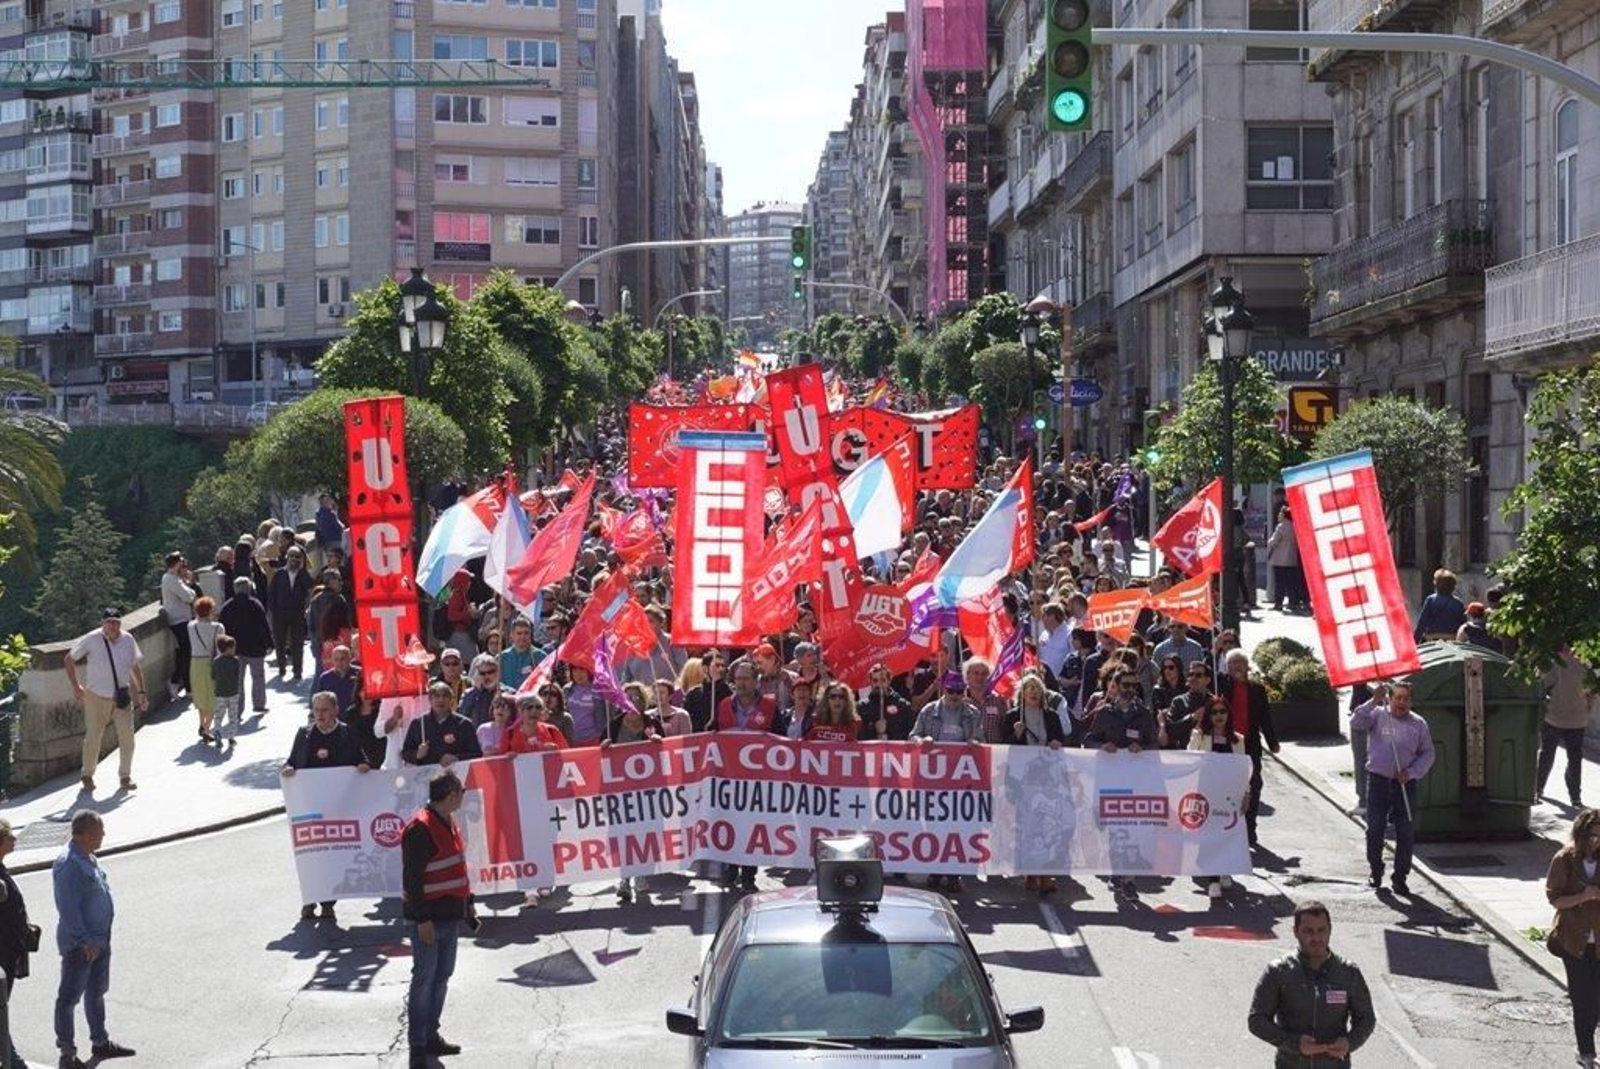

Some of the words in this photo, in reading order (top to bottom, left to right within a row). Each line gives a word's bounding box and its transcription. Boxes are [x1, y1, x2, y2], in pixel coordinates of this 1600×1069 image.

[361, 437, 407, 660] UGT
[692, 451, 746, 631] CCOO
[1304, 474, 1396, 670] CCOO
[859, 593, 904, 619] UGT
[556, 761, 587, 788] A
[601, 742, 723, 784] LOITA
[739, 743, 981, 781] CONTINÚA
[575, 785, 689, 829] DEREITOS
[710, 777, 841, 818] IGUALDADE
[875, 785, 993, 822] COHESIÓN
[1105, 801, 1164, 813] CCOO
[1183, 798, 1206, 815] UGT
[296, 824, 356, 841] CCOO
[374, 818, 401, 832] UGT
[552, 820, 735, 874] PRIMEIRO
[745, 823, 798, 855] AS
[810, 826, 991, 863] PRSOAS
[480, 862, 538, 882] MAIO
